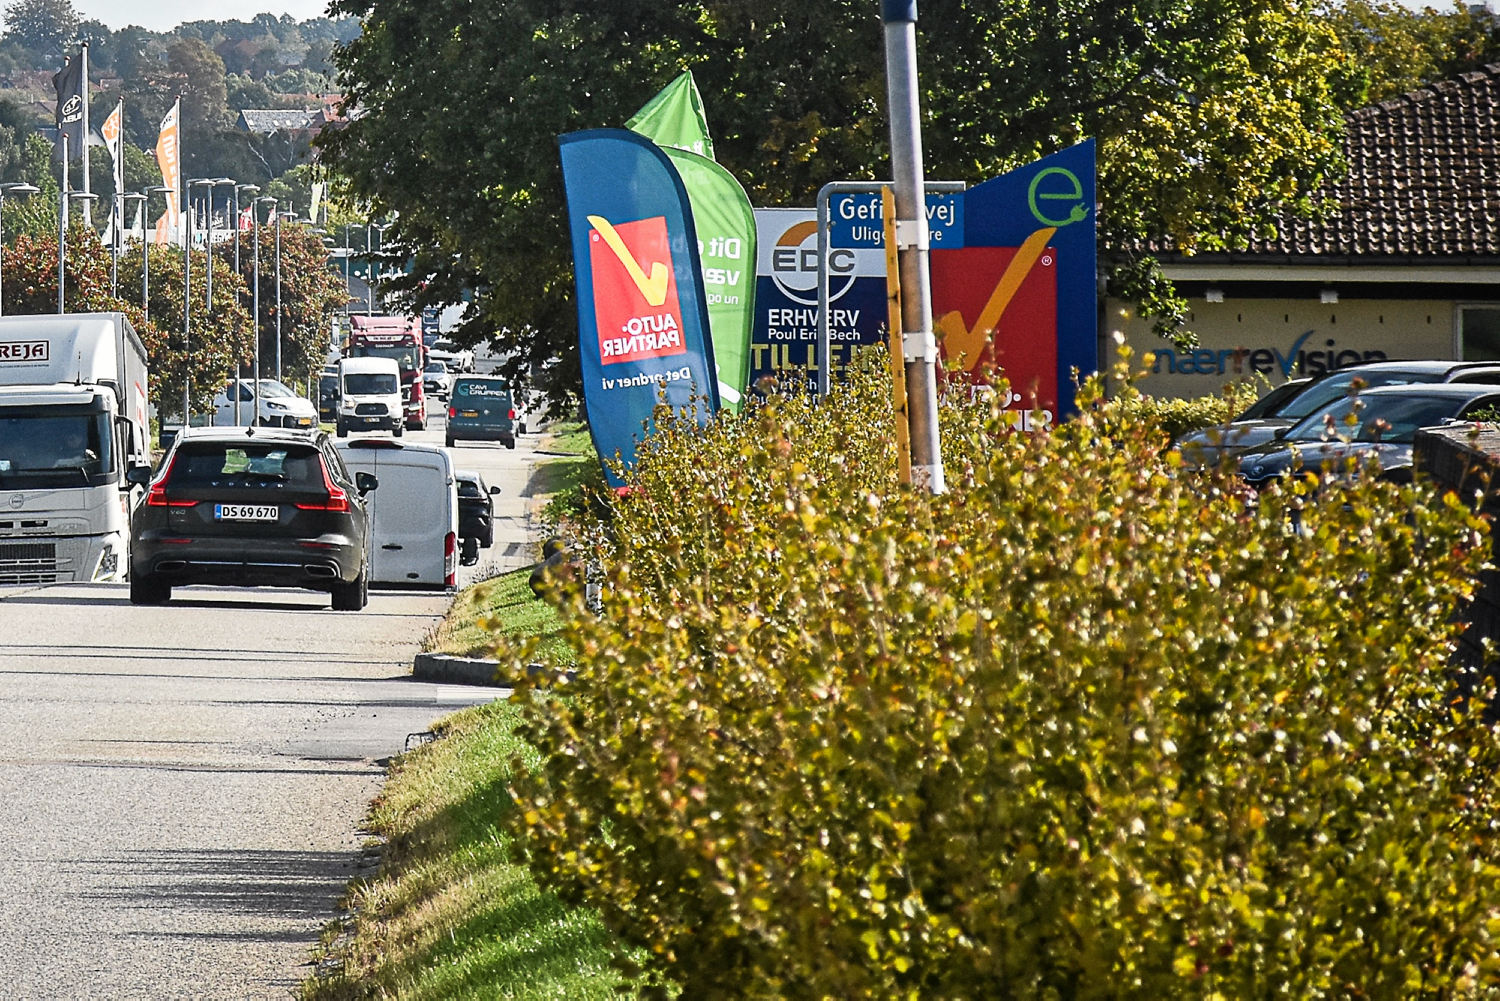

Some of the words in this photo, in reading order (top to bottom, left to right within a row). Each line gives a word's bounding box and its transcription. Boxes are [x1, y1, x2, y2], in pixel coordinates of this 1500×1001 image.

[840, 197, 955, 227] Gefivej
[772, 248, 856, 273] EDC
[768, 308, 860, 327] ERHVERV
[768, 329, 797, 340] Poul
[800, 329, 818, 340] Eri
[829, 329, 861, 340] Bech
[222, 506, 238, 517] DS
[240, 507, 255, 518] 69
[256, 507, 277, 518] 670
